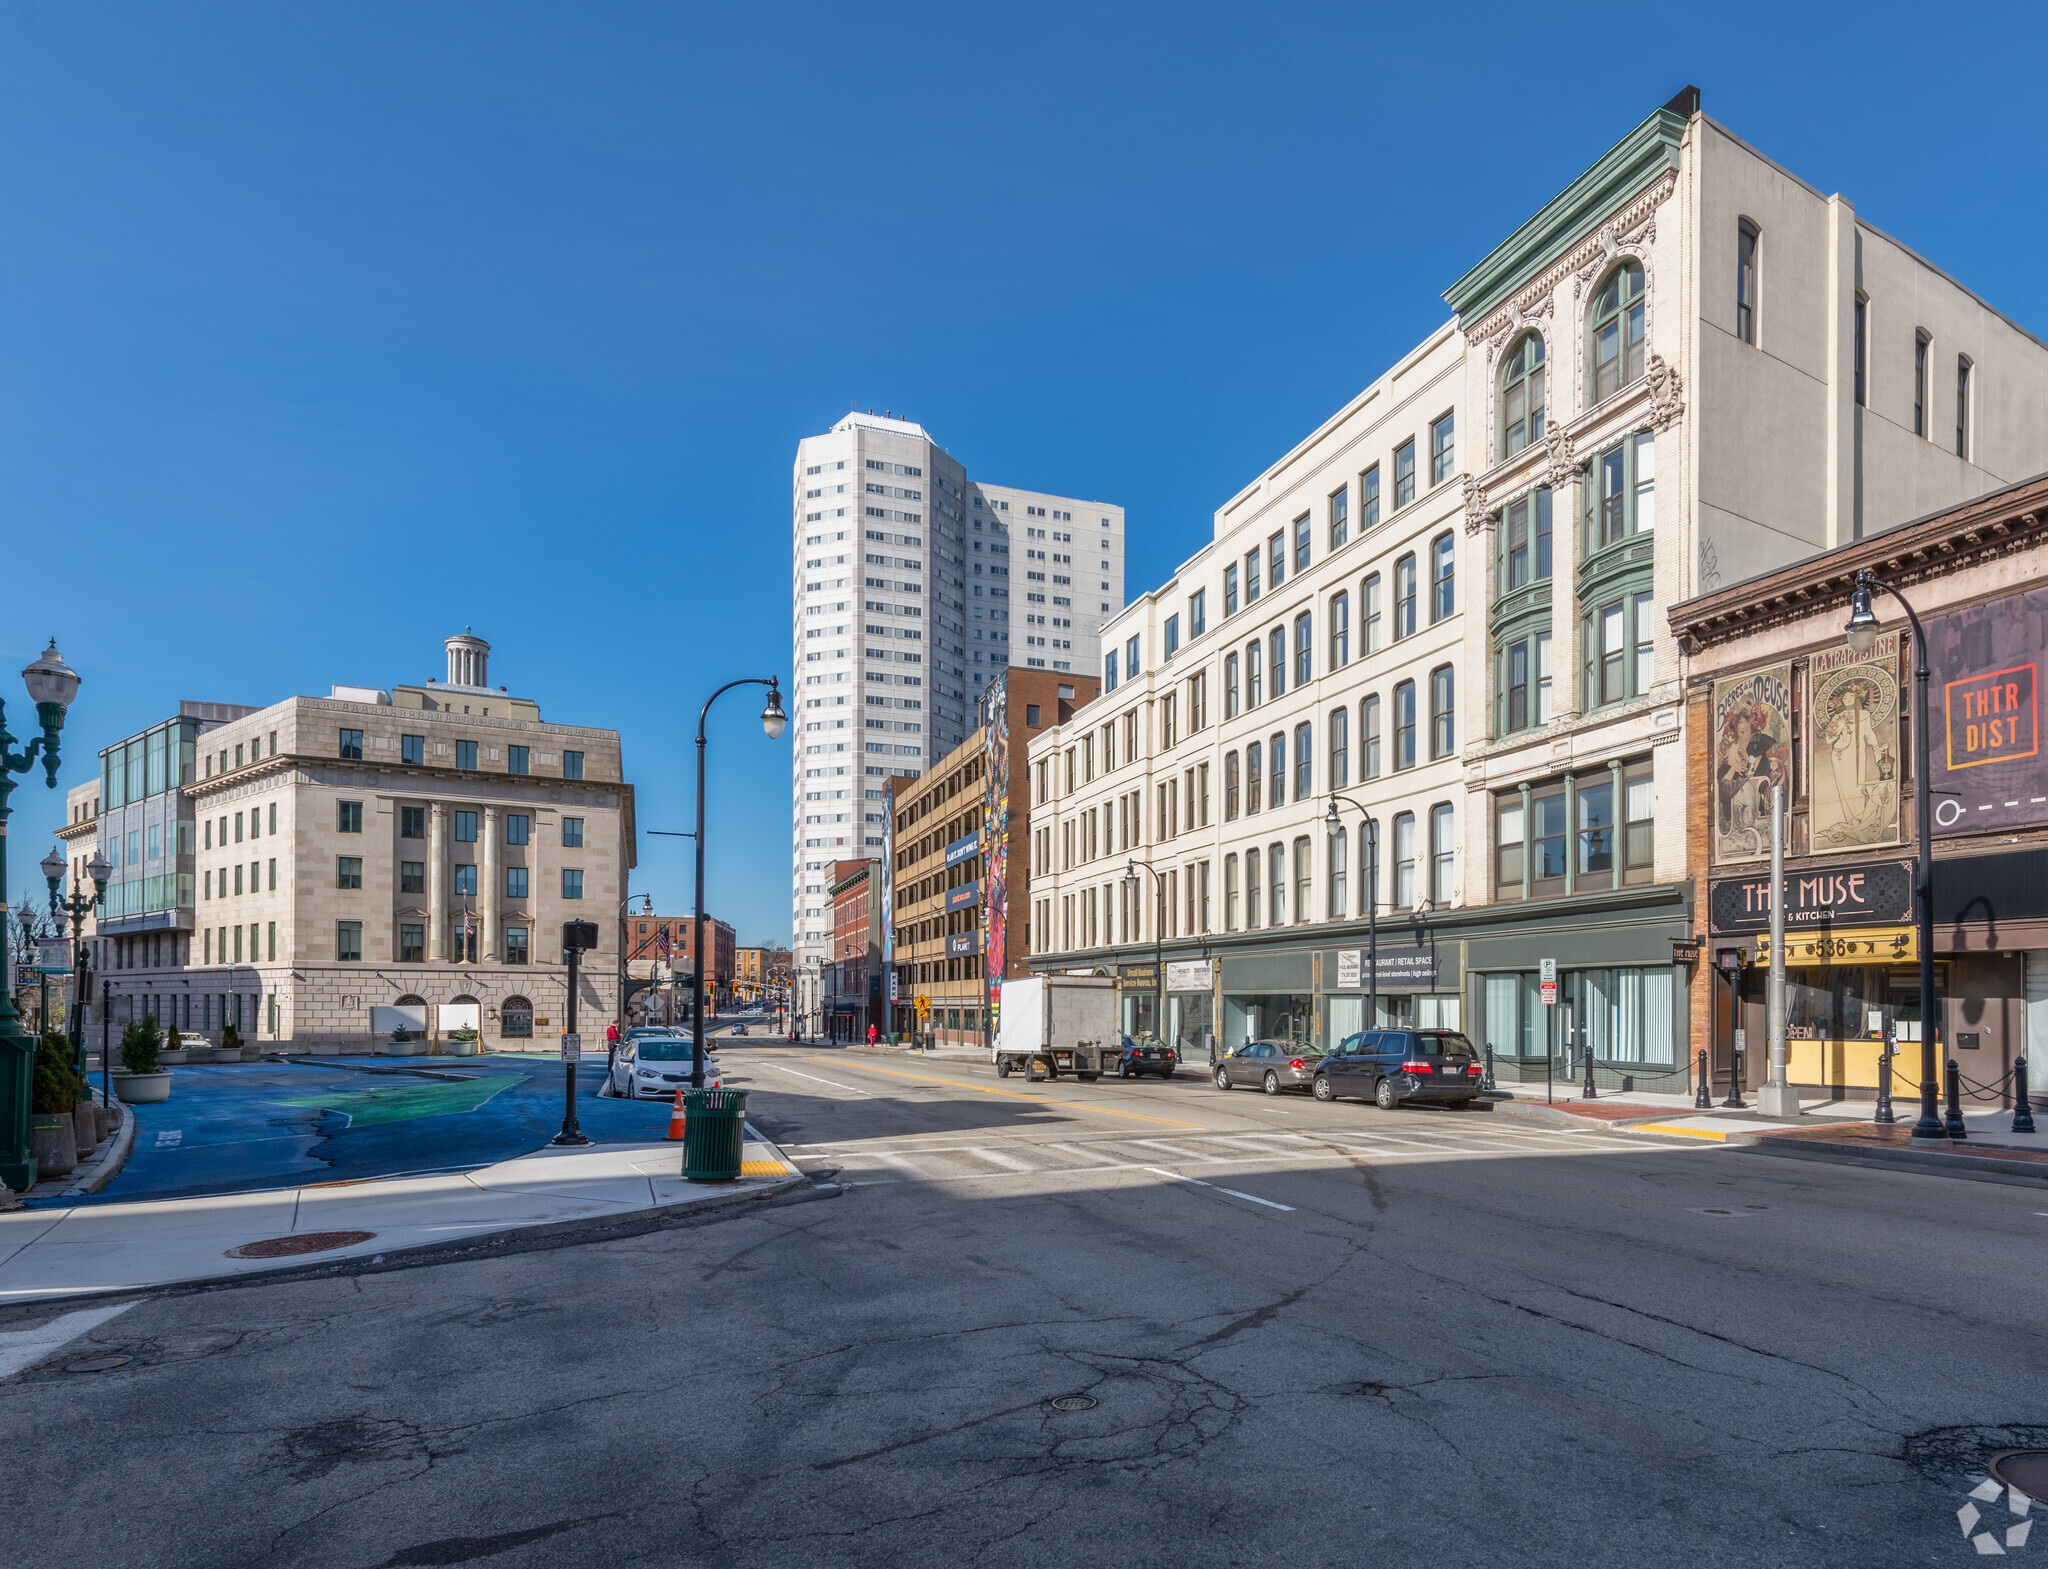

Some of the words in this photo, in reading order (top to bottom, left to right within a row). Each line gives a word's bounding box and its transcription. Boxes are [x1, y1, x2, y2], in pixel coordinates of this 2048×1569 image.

[1815, 654, 1828, 672] LA
[1753, 675, 1789, 720] MEUSE
[1962, 682, 2019, 719] THTR
[1966, 715, 2019, 752] DIST
[1742, 880, 1789, 911] TH
[1800, 873, 1865, 908] MUSE
[1788, 912, 1793, 922] &
[1795, 910, 1835, 921] KITCHEN
[1673, 949, 1684, 957] THE
[1685, 949, 1698, 958] MUSE
[1815, 938, 1846, 958] 536
[1364, 958, 1394, 967] REAURANT
[1397, 957, 1414, 966] RETAIL
[1415, 956, 1432, 965] SPACE
[1127, 968, 1137, 977] Small
[1137, 967, 1154, 977] Business
[1122, 979, 1136, 987] Service
